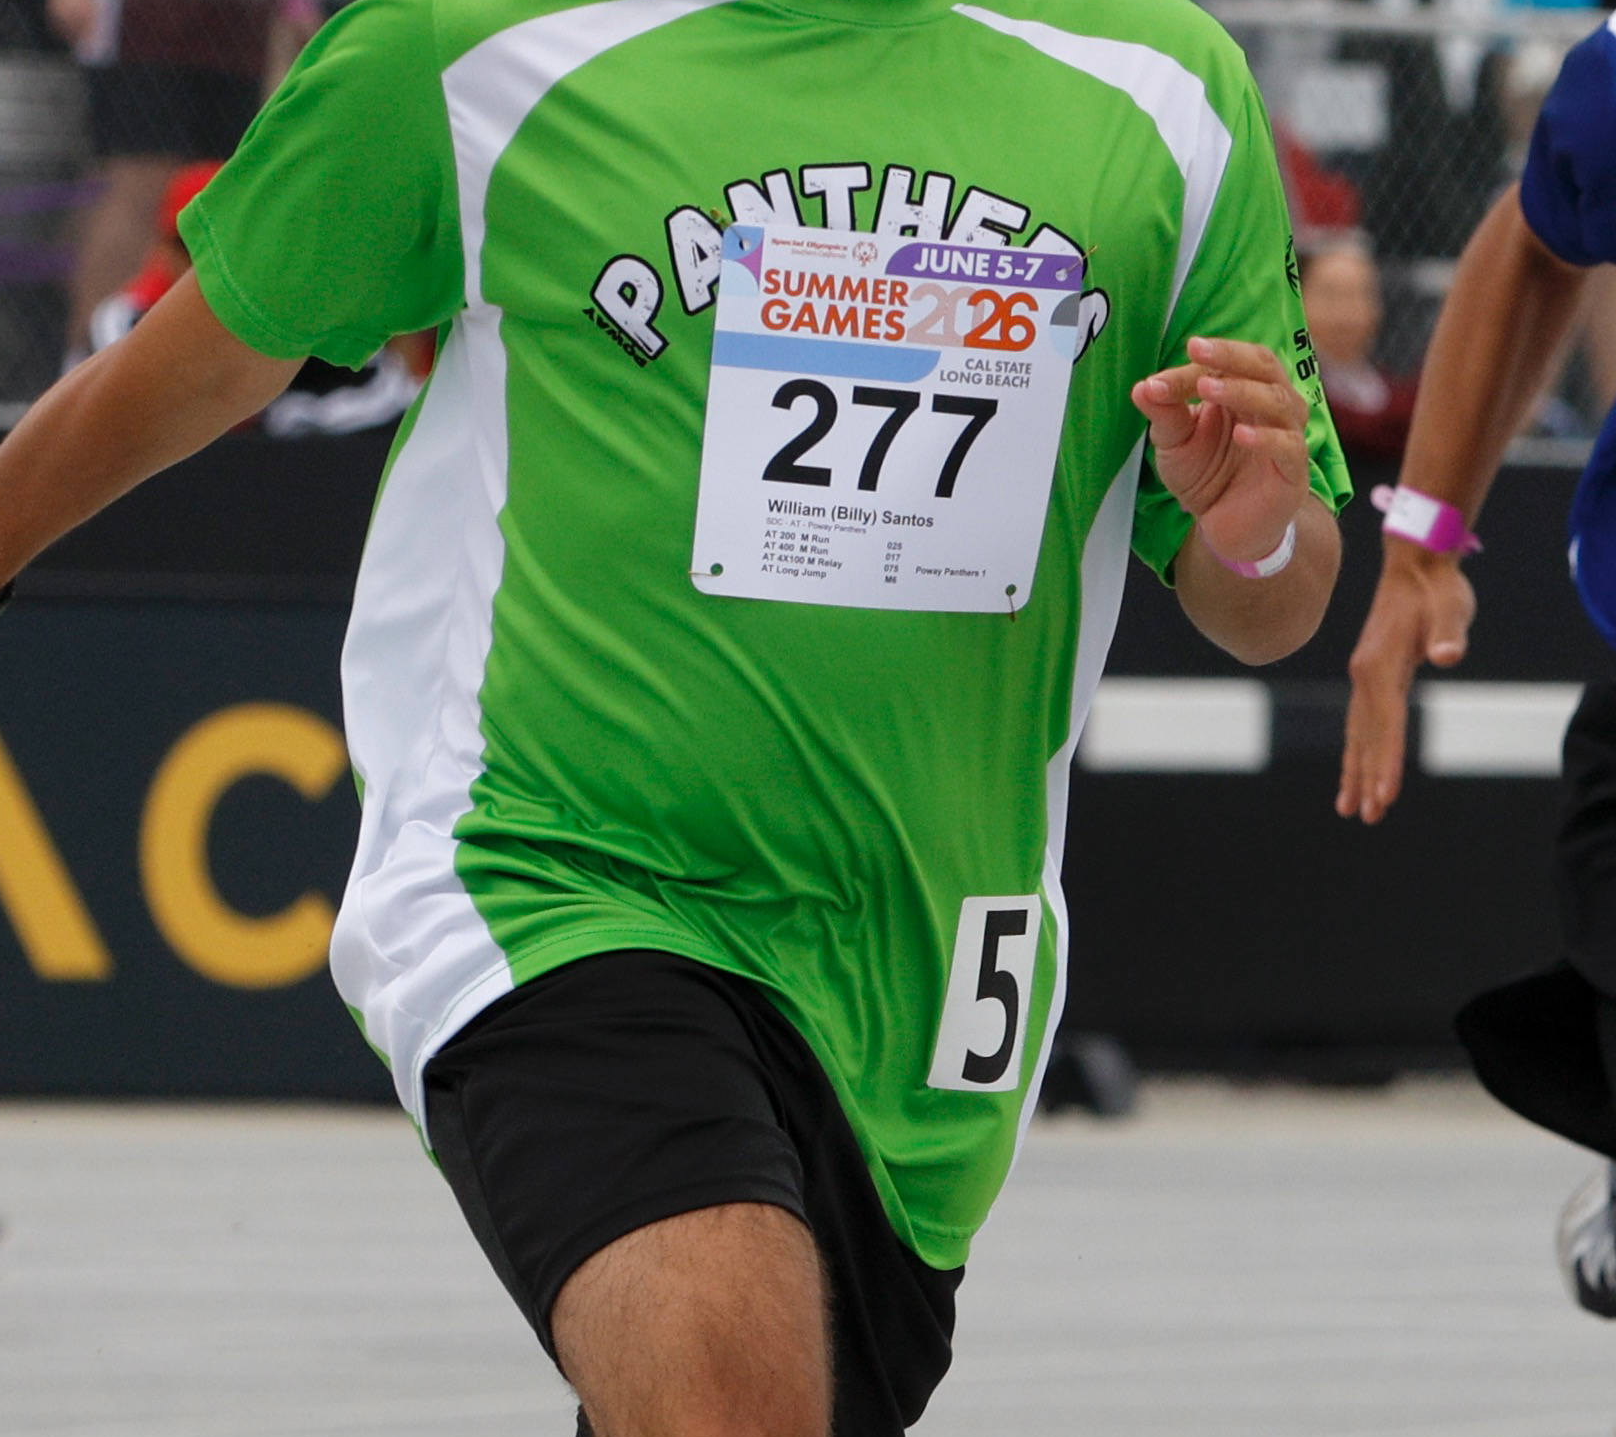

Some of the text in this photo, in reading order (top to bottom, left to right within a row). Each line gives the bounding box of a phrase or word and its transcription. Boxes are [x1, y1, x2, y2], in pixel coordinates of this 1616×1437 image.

[913, 247, 1044, 281] JUNE 5-7
[763, 269, 909, 307] SUMMER
[761, 299, 906, 342] GAMES
[906, 282, 1039, 352] 2026
[582, 307, 648, 367] POWAY
[965, 358, 1032, 375] CAL STATE
[939, 370, 1030, 389] LONG BEACH
[761, 379, 999, 499] 277
[768, 498, 934, 528] William (Billy) Santos
[765, 530, 830, 543] AT 200 M Run
[808, 521, 832, 532] Poway
[834, 523, 866, 534] Panthers
[763, 541, 828, 555] AT 400 M Run
[885, 553, 901, 561] 017
[762, 553, 842, 569] AT 4X100 M Relay
[761, 564, 827, 579] AT Long Jump
[915, 566, 942, 576] Poway
[944, 568, 979, 577] Panthers
[961, 909, 1029, 1085] 5
